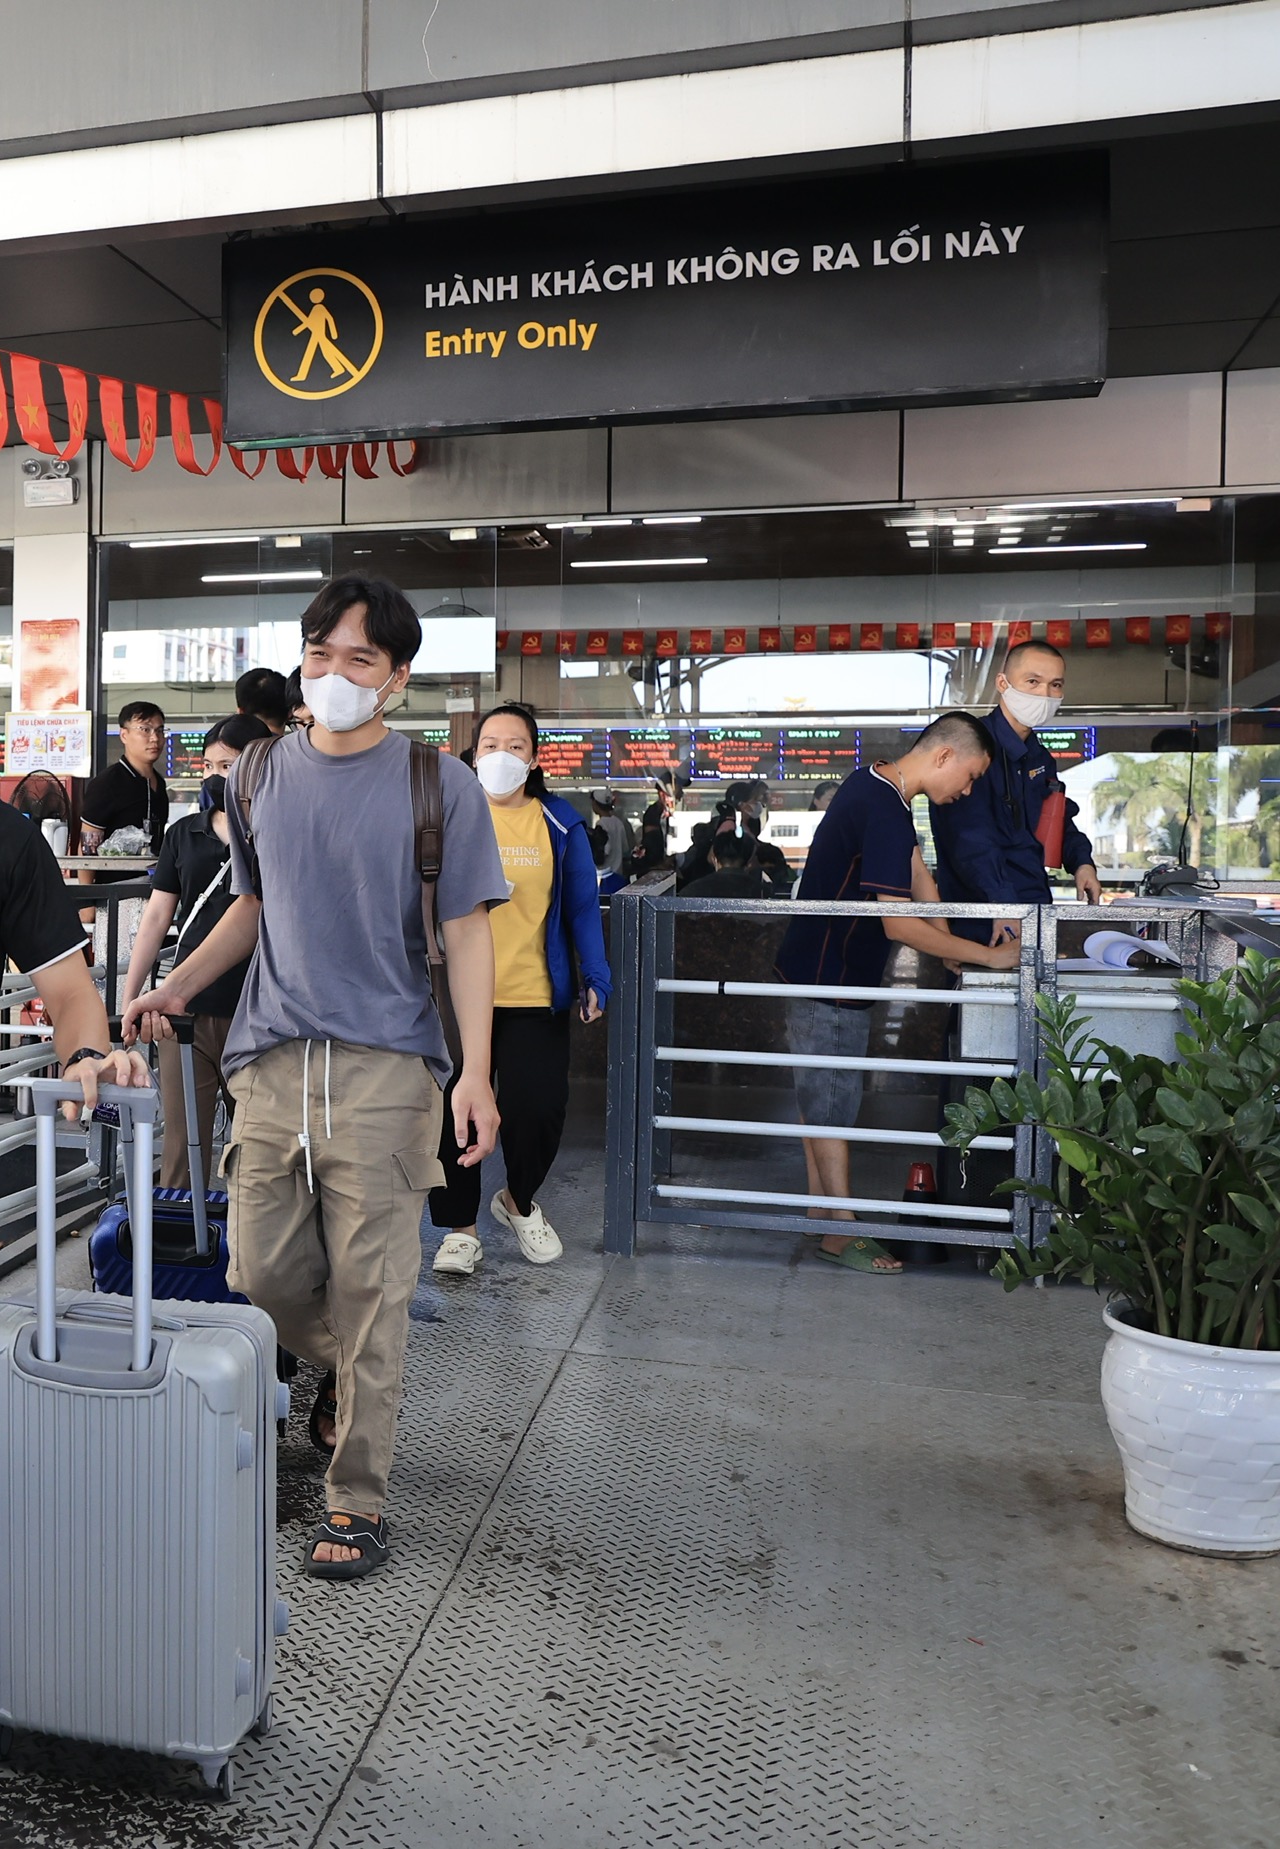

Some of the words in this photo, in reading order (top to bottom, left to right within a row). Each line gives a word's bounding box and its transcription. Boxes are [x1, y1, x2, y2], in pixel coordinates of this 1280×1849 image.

[425, 273, 518, 309] HÀNH
[531, 259, 654, 298] KHÁCH
[667, 246, 800, 286] KHÔNG
[813, 242, 861, 272] RA
[873, 223, 930, 266] LỐI
[945, 221, 1025, 260] NÀY
[425, 327, 507, 359] Entry
[517, 318, 598, 351] Only
[513, 857, 543, 867] FINE.
